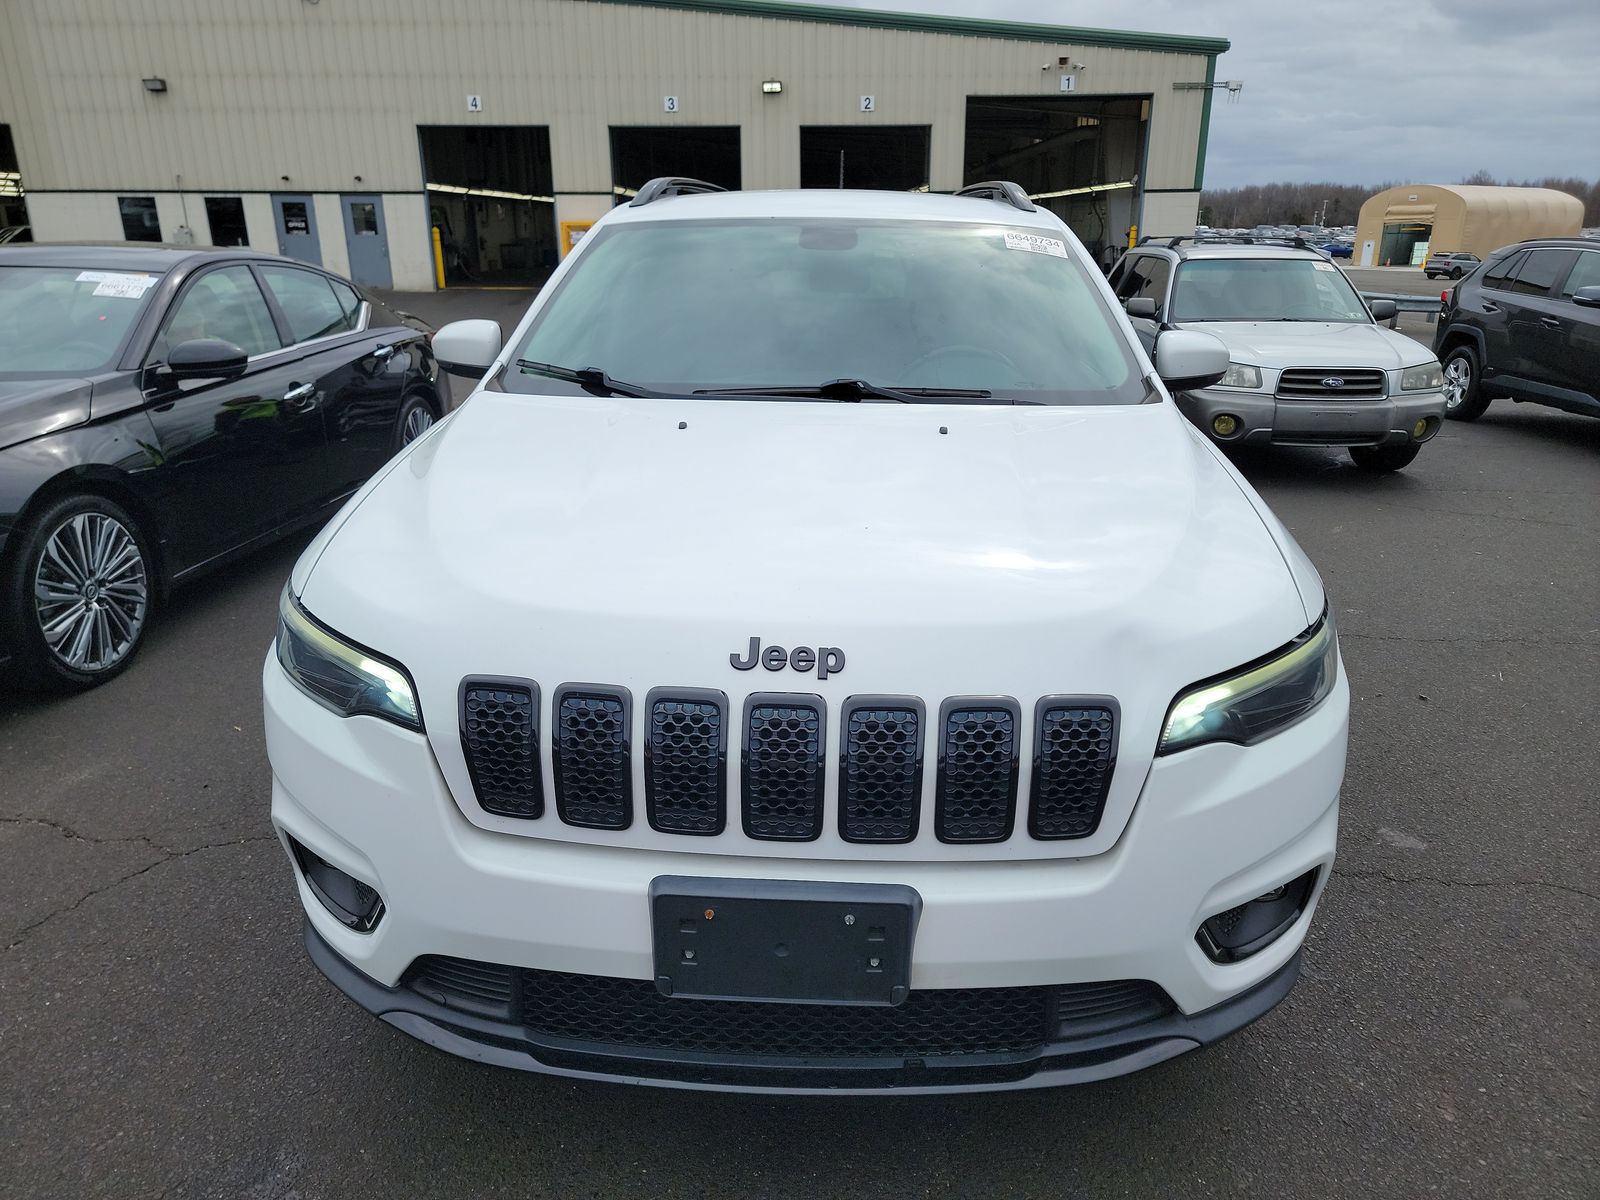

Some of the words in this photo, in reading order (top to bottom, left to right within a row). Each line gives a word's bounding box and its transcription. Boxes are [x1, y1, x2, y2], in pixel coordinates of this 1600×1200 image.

[1065, 76, 1071, 90] 1
[471, 96, 478, 110] 4
[667, 97, 675, 110] 3
[864, 97, 872, 110] 2
[1006, 232, 1060, 248] 6649734
[729, 636, 846, 680] Jeep
